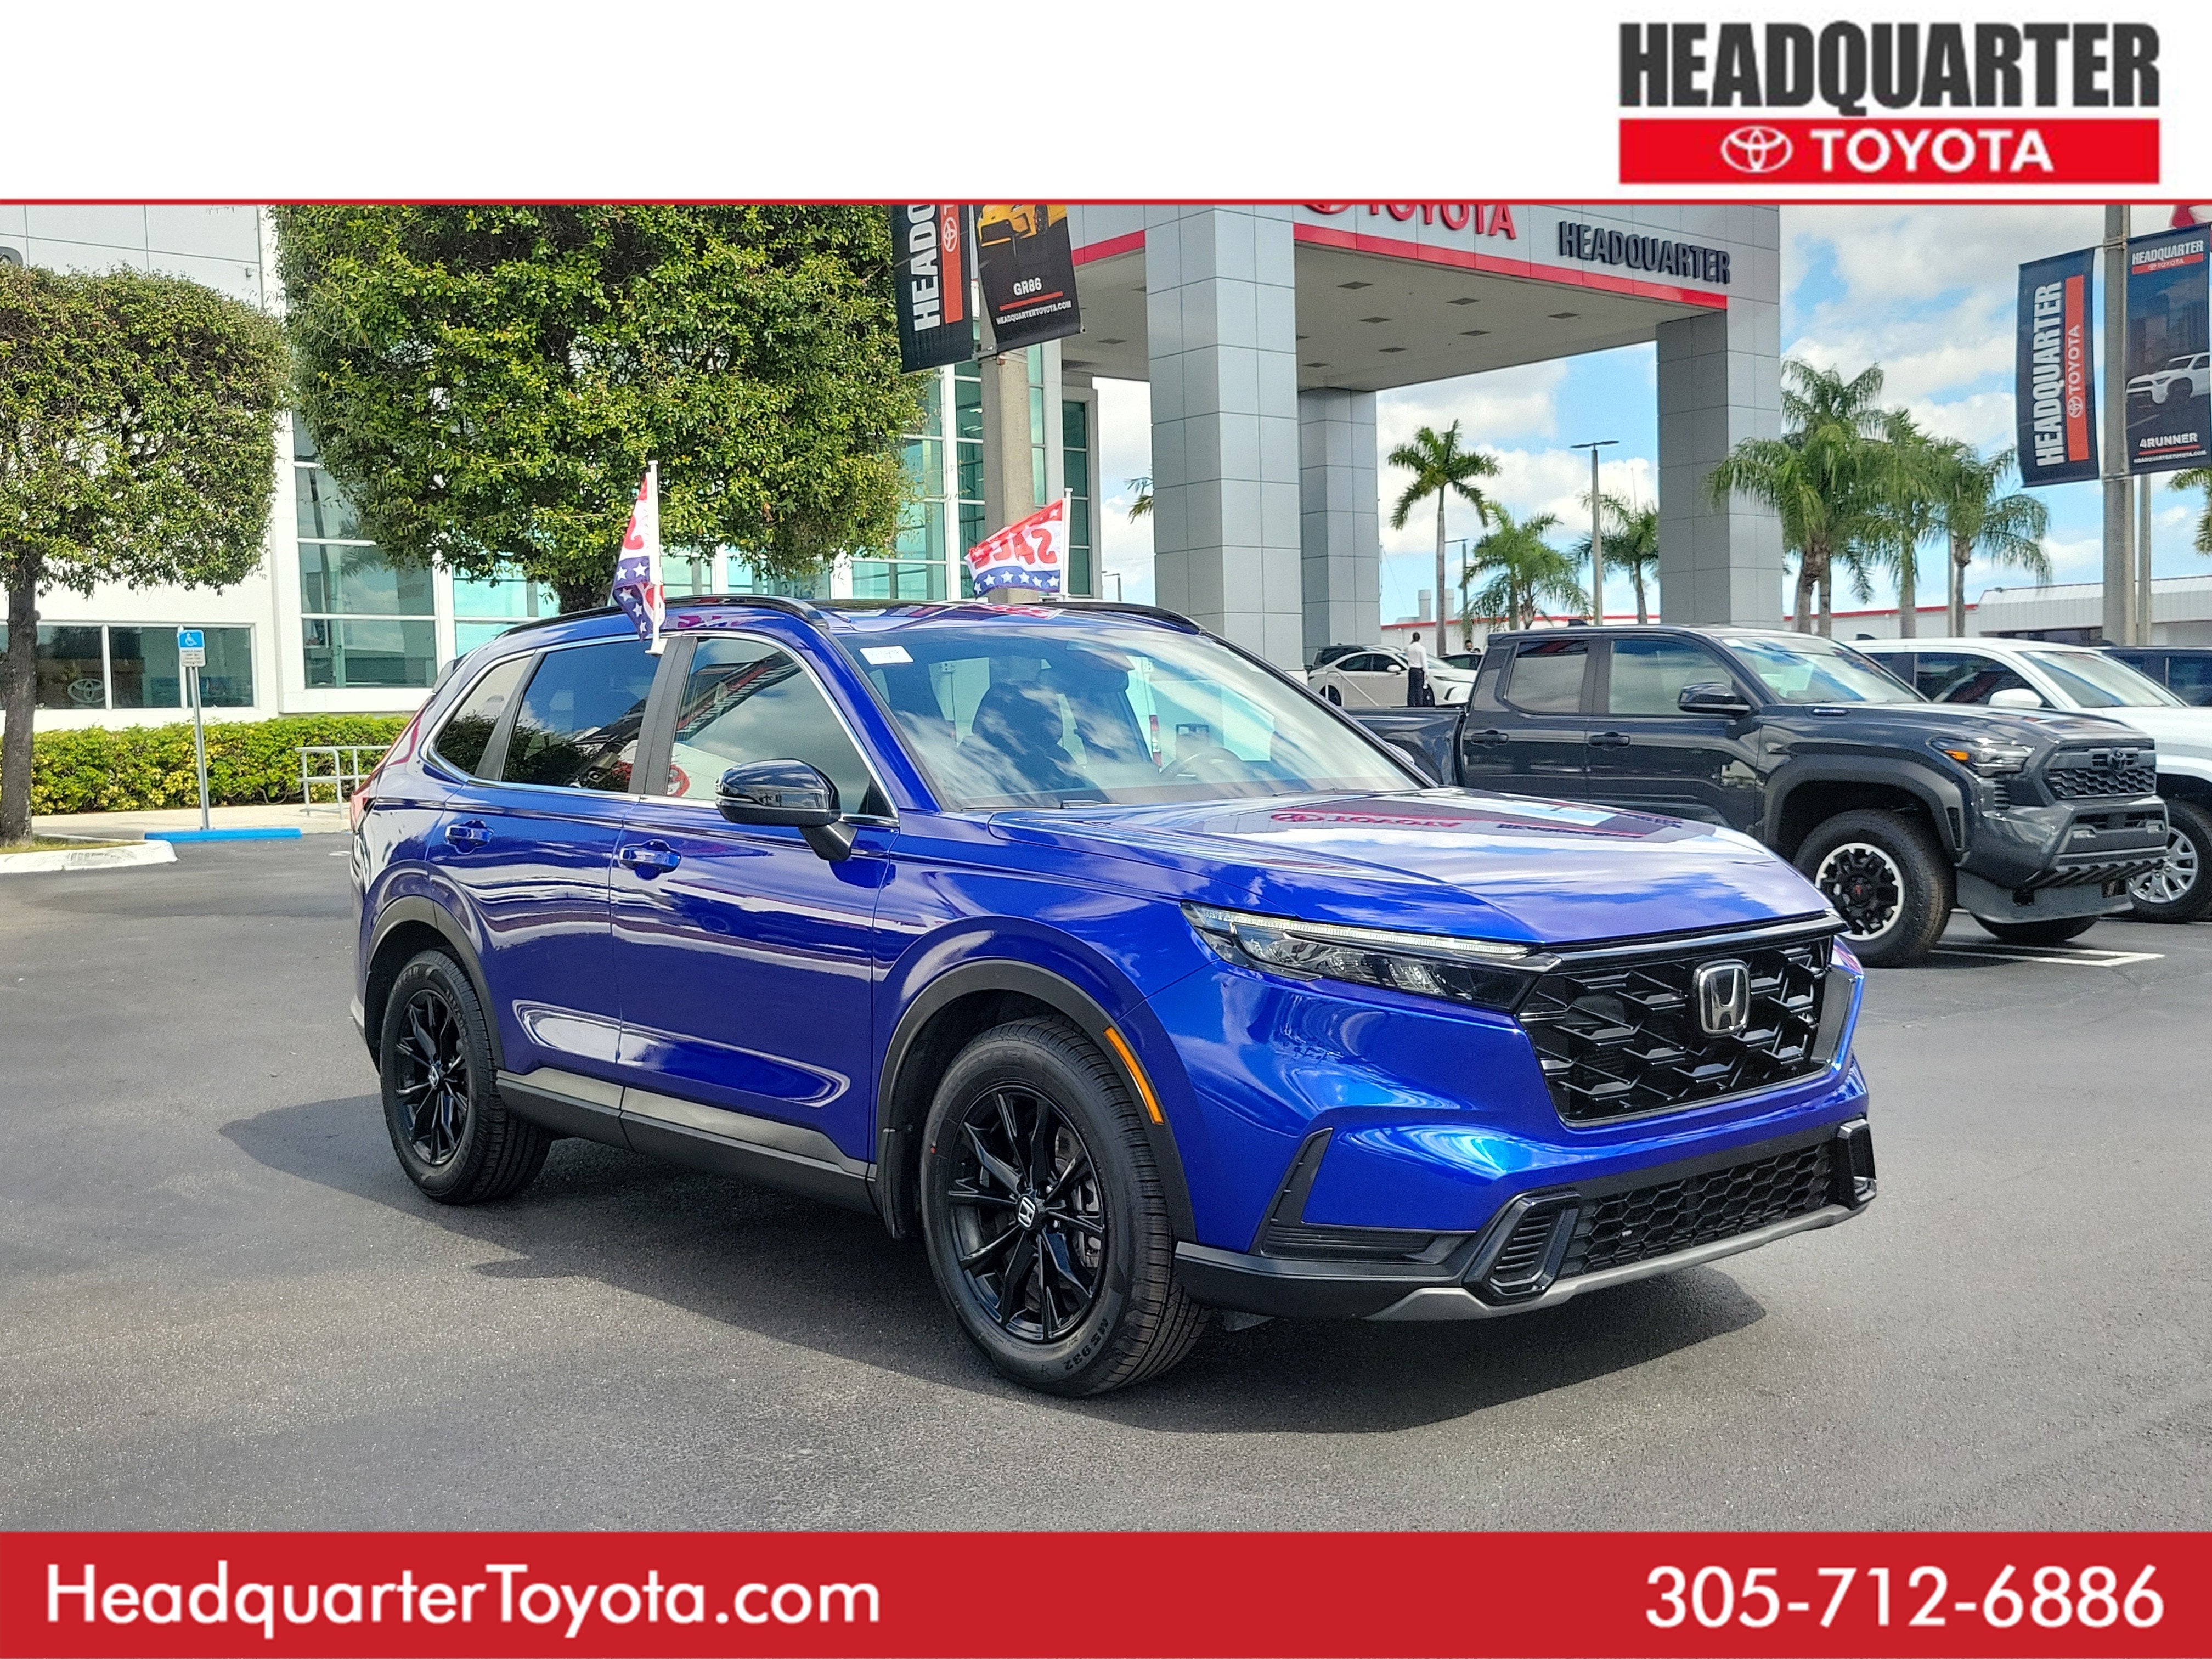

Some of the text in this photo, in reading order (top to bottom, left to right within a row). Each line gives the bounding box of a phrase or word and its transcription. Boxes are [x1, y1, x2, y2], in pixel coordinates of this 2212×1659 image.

[1559, 221, 1730, 284] HEADQUARTER
[2131, 240, 2204, 265] HEADQUARTER
[2156, 258, 2184, 268] TOYOTA
[1013, 277, 1042, 296] GR86
[2067, 324, 2080, 395] TOYOTA
[2033, 281, 2065, 467] HEADQUARTER
[2140, 432, 2198, 448] 4RUNNER
